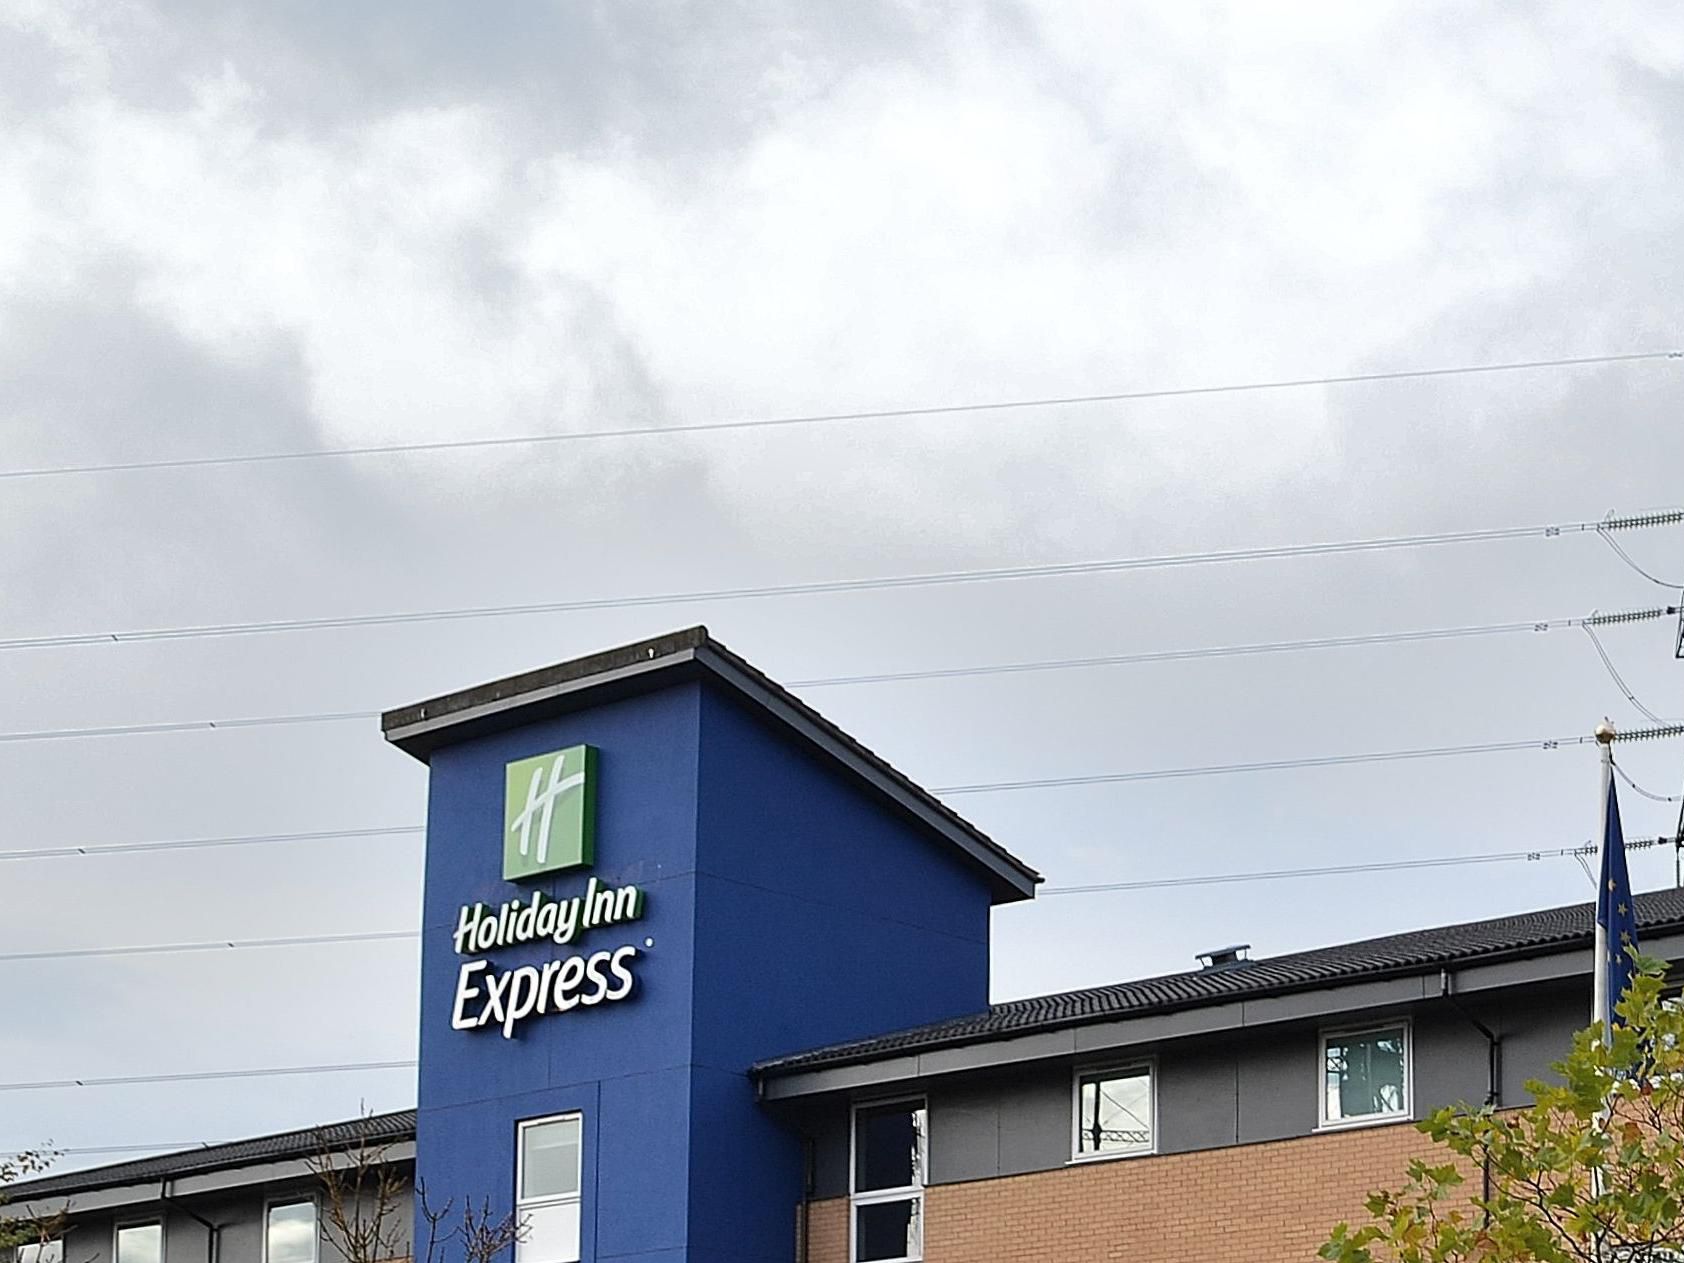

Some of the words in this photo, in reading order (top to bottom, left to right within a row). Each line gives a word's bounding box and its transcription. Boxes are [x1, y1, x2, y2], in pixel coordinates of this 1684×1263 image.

[452, 890, 581, 954] Holiday
[581, 877, 638, 928] Inn
[451, 946, 637, 1039] Express
